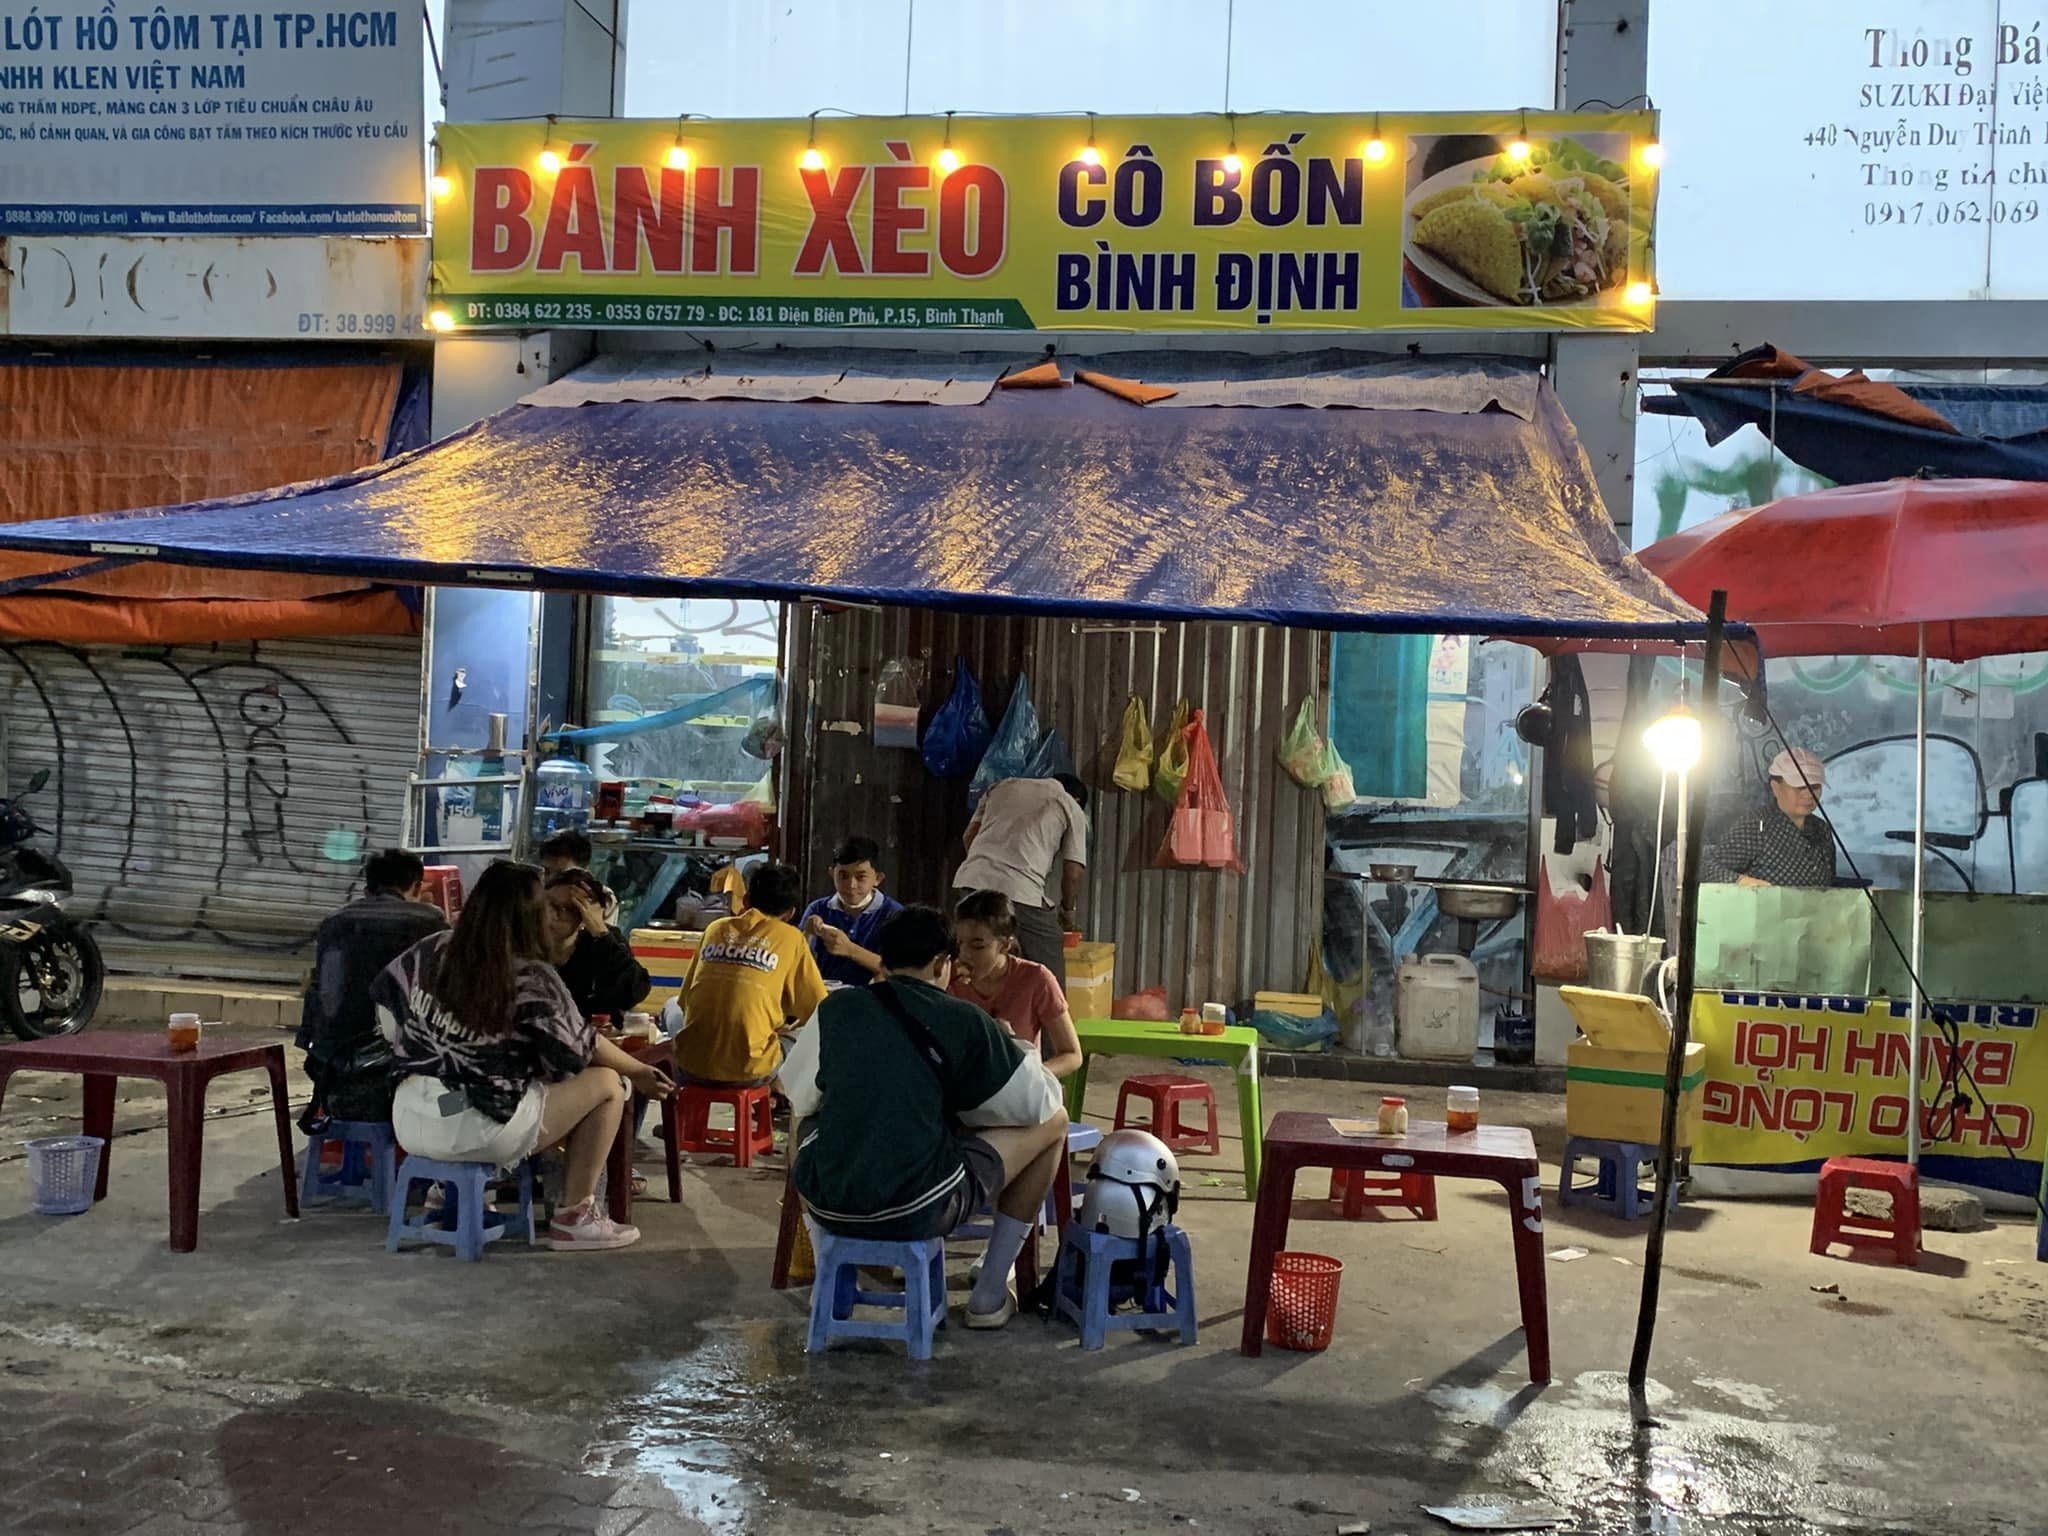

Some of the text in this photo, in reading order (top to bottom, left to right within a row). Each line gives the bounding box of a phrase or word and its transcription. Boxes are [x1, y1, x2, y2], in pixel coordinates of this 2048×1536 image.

[4, 0, 397, 57] LÓT HỒ TÔM TẠI TP.HCM
[1996, 20, 2048, 65] Bá
[53, 65, 117, 91] KLEN
[125, 58, 181, 95] VIỆT
[191, 65, 246, 90] NAM
[1859, 83, 1952, 108] SUZUKI
[61, 101, 102, 117] HDPE,
[106, 99, 145, 115] MÀNG
[181, 101, 190, 114] 3
[312, 96, 350, 113] CHÂU
[131, 127, 151, 141] GIA
[154, 124, 186, 140] CÔNG
[246, 126, 277, 140] THEO
[356, 121, 380, 138] YÊU
[1055, 132, 1366, 229] CÔ BỐN
[469, 140, 1009, 279] BÁNH XÈO
[1055, 241, 1361, 325] BÌNH ĐỊNH
[297, 312, 329, 334] ĐT:
[335, 313, 397, 334] 38.999
[468, 302, 1005, 327] ĐT: 0384 622 235 0353 6757 79 ĐC: 181 Điện Biên Phủ, P.15, Bình Thạnh
[1734, 1020, 2016, 1093] BÁNH HỎI
[1702, 1079, 1858, 1144] LÒNG
[1521, 1175, 1543, 1233] 5
